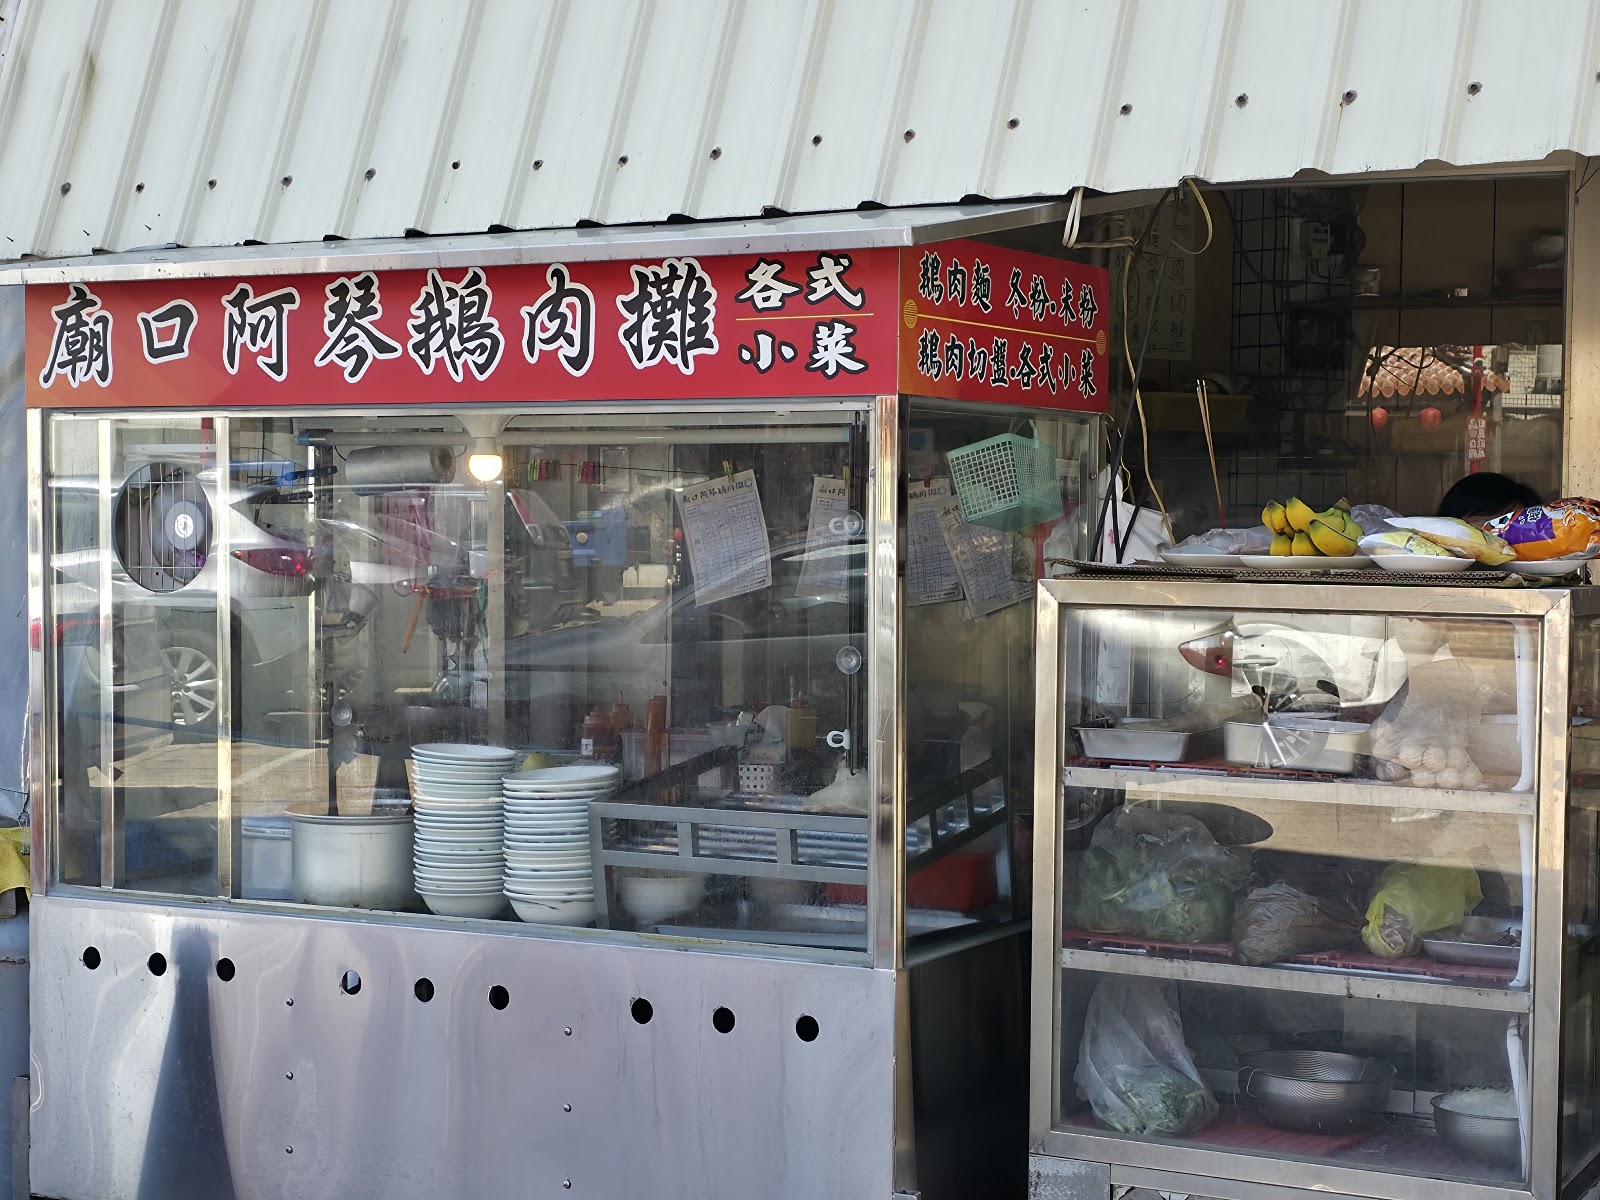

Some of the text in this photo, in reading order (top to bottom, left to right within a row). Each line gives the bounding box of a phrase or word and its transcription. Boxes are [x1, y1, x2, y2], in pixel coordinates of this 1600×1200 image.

[735, 251, 865, 312] 各式
[919, 251, 992, 313] 鵝肉麵
[40, 258, 718, 388] 廟口阿琴鵝肉攤
[737, 318, 869, 380] 小菜
